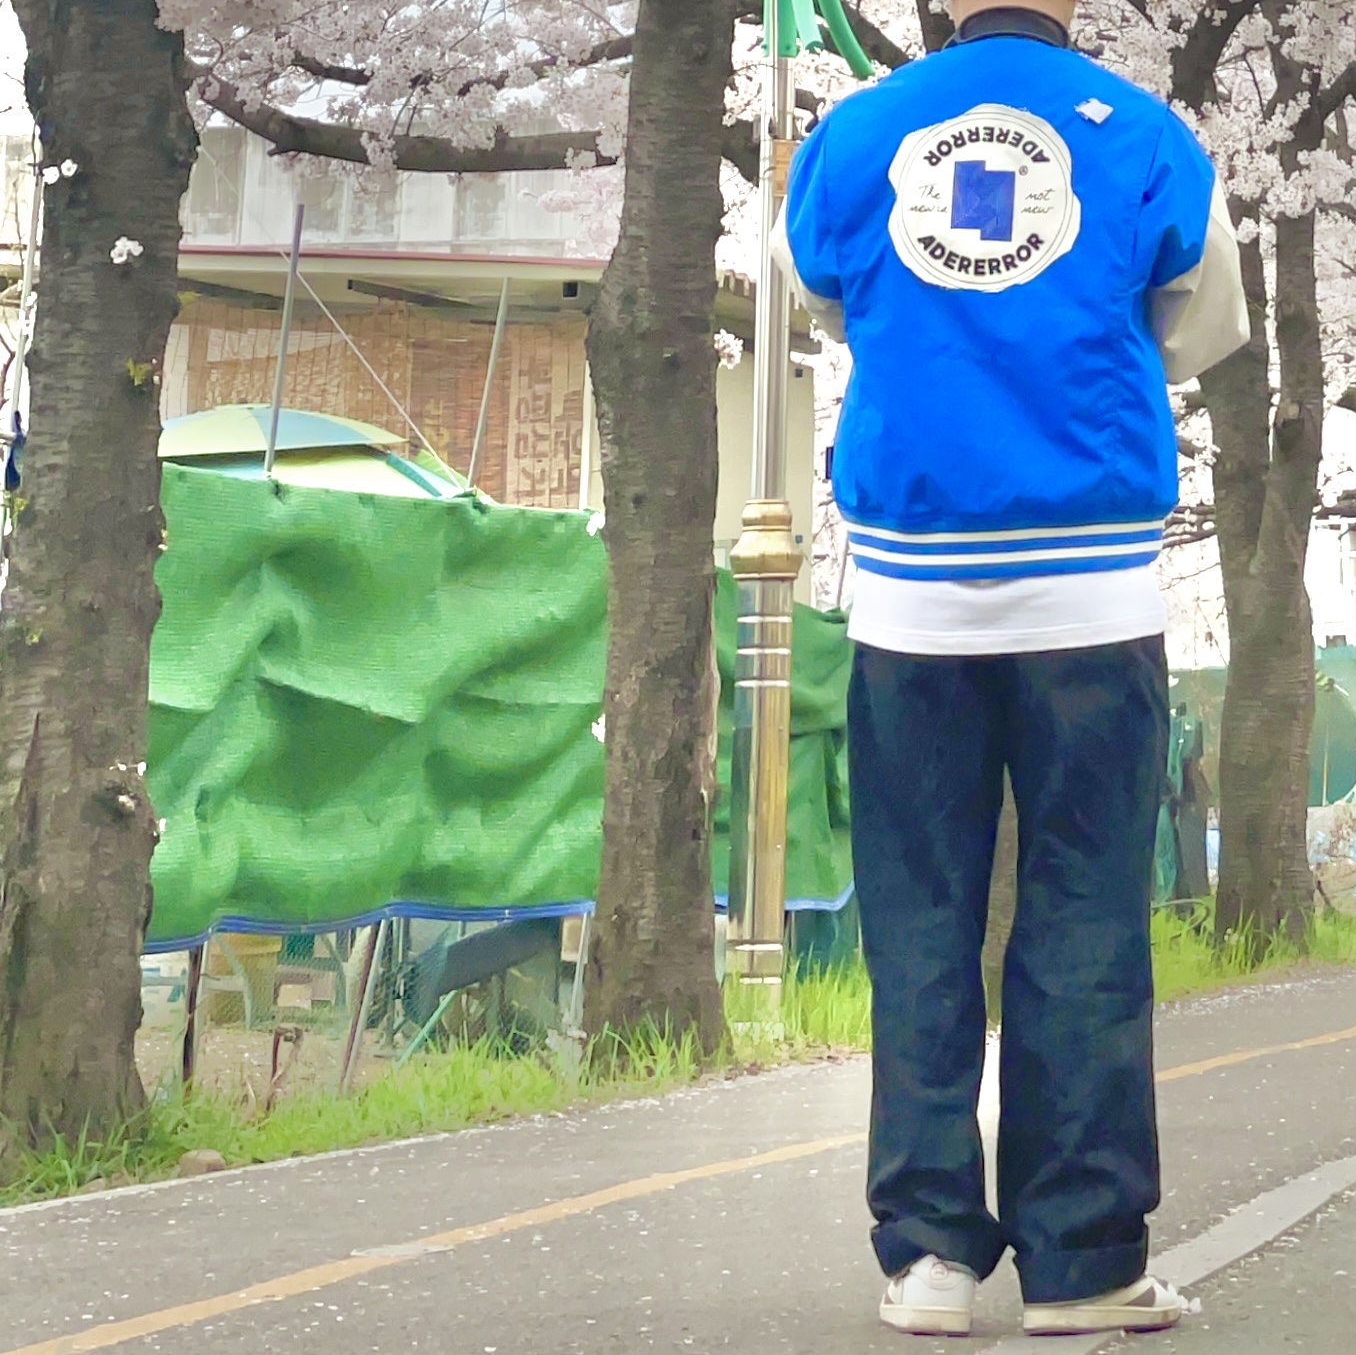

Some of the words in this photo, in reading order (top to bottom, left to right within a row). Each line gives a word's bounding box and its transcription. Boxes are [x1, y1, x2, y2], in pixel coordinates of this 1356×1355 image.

[923, 126, 1051, 167] ADERERROR
[918, 184, 942, 200] The
[1025, 188, 1056, 201] not
[1020, 205, 1055, 215] new
[916, 232, 1045, 277] ADERERROR
